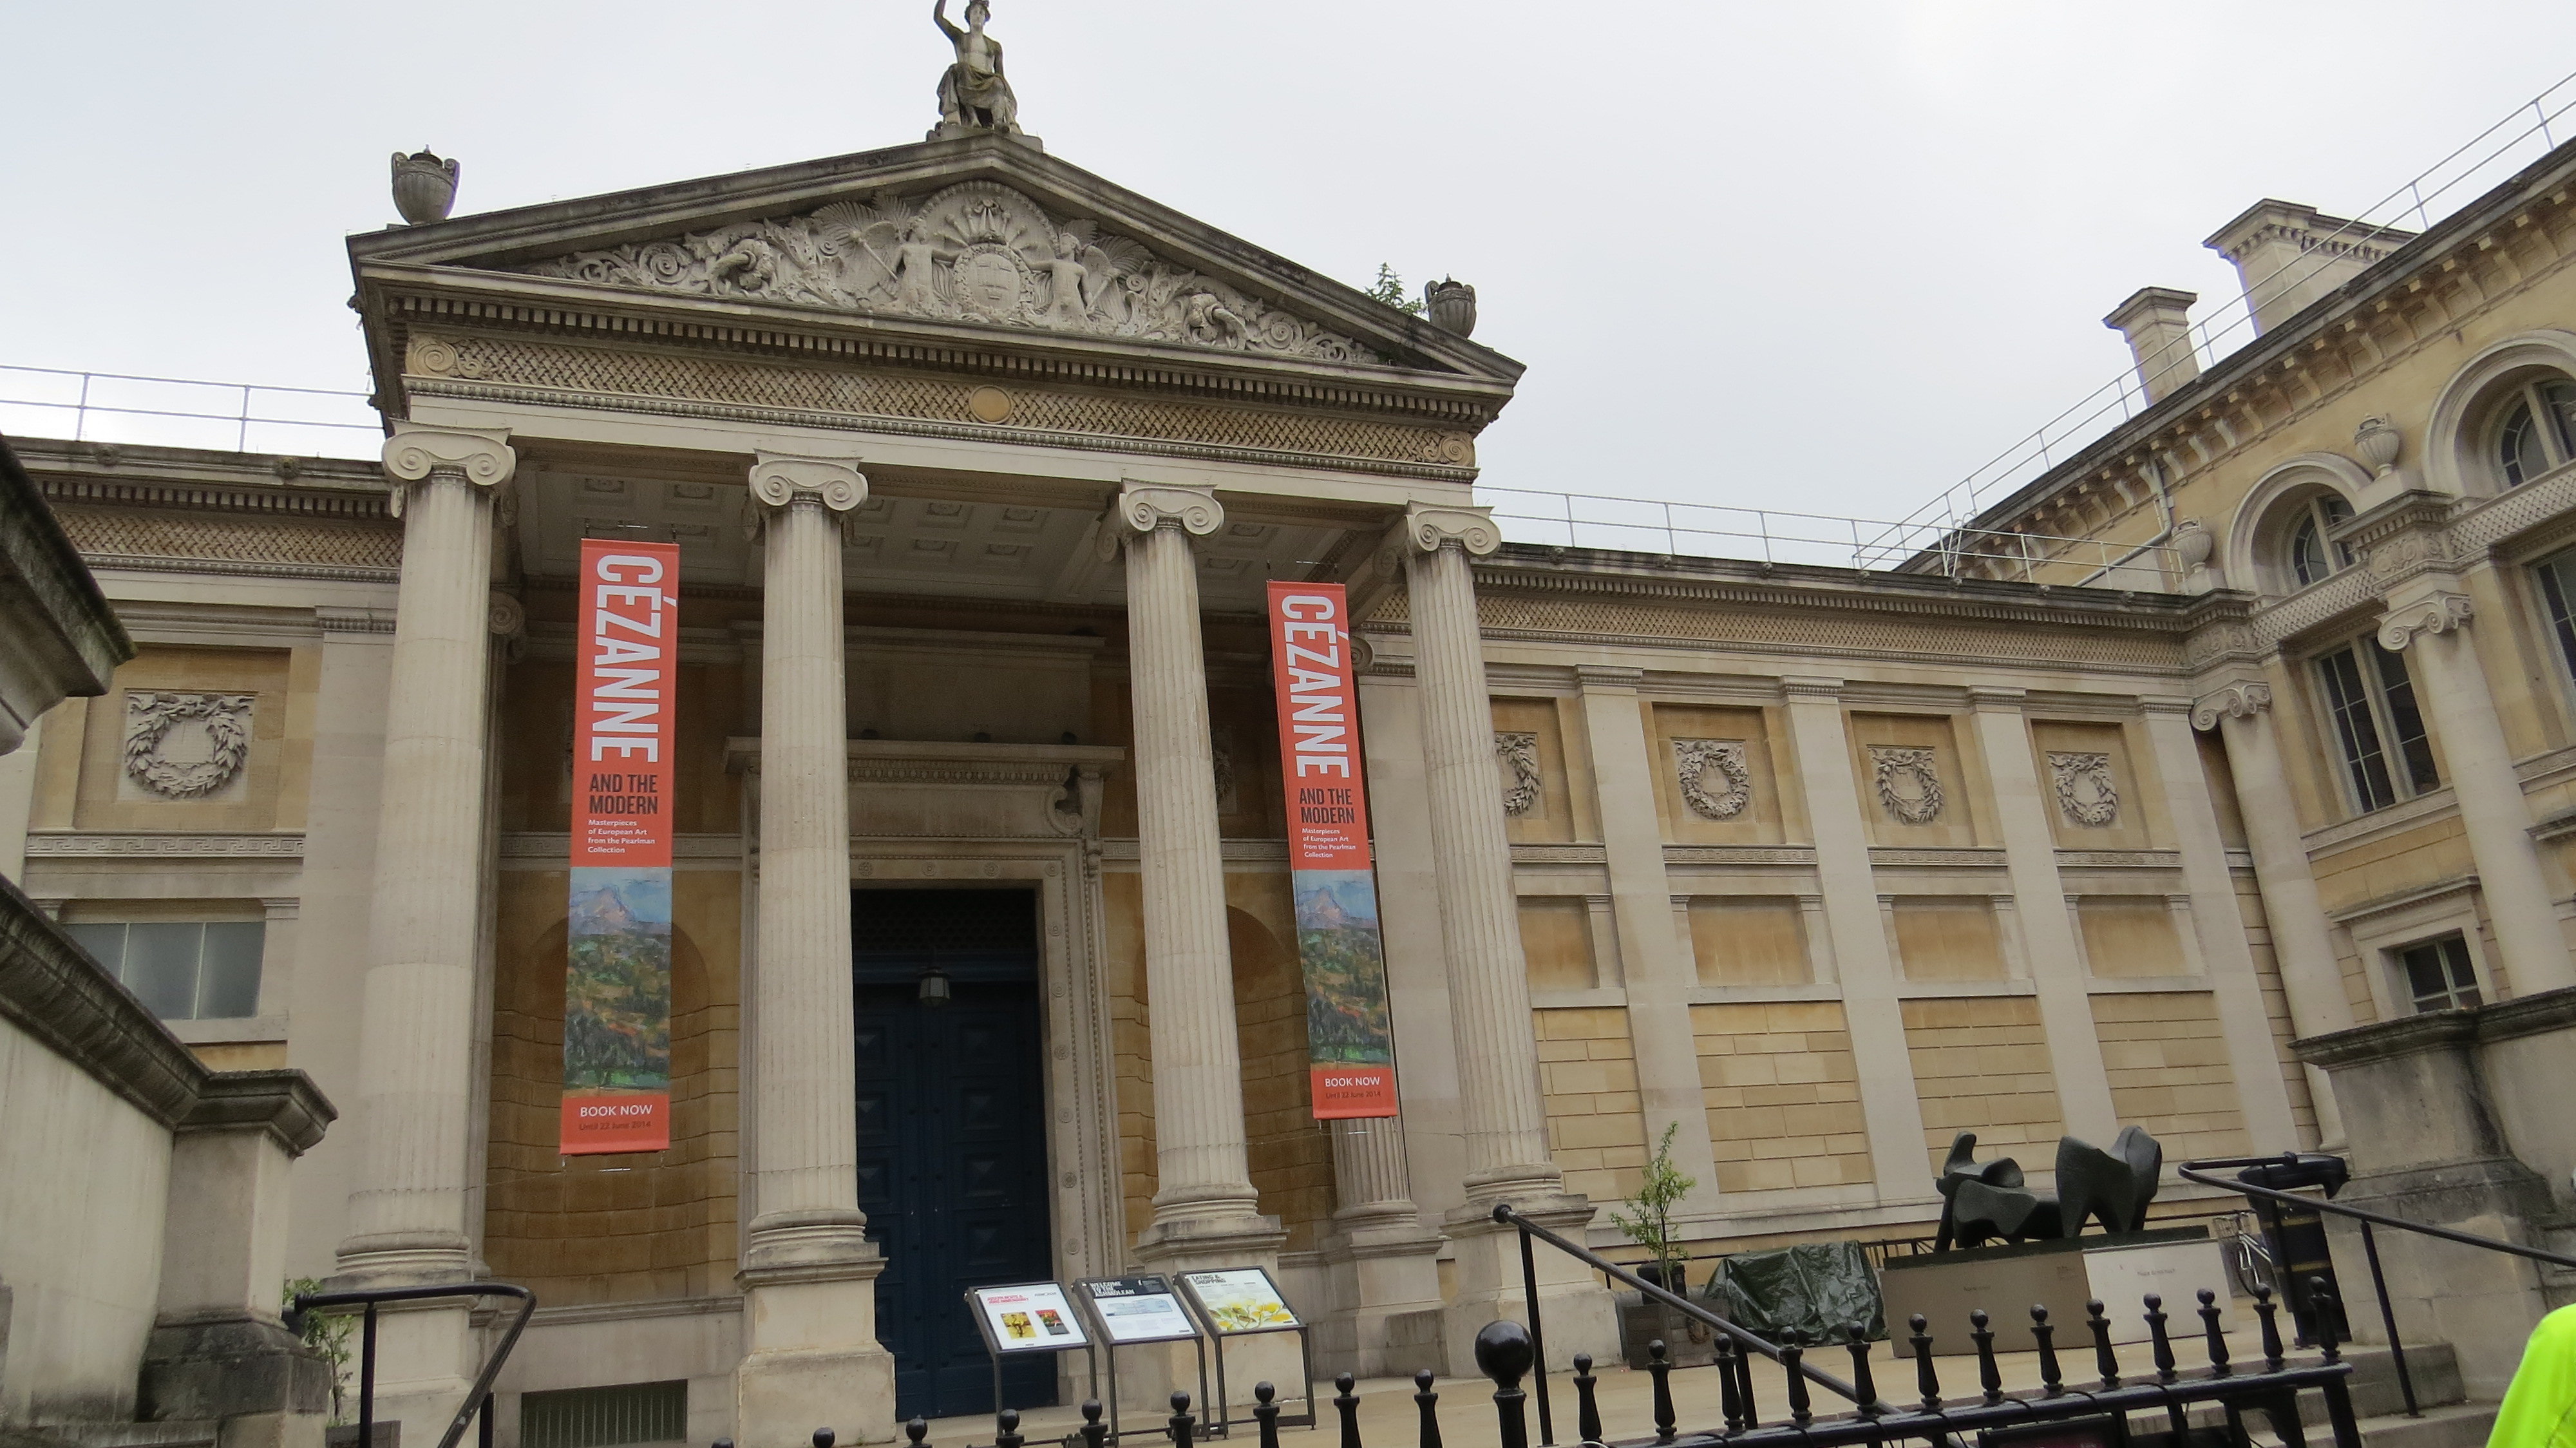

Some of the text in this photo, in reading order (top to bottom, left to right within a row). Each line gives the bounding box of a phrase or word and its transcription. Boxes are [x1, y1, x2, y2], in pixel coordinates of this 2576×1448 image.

[591, 555, 676, 762] CÉZANNE
[1282, 595, 1349, 777] CÉZANNE
[589, 774, 658, 793] AND THE
[589, 795, 658, 814] MODERN
[1300, 788, 1352, 805] AND THE
[1301, 806, 1355, 824] MODERN
[1325, 1076, 1380, 1087] BOOK NOW
[580, 1104, 653, 1117] BOOK NOW
